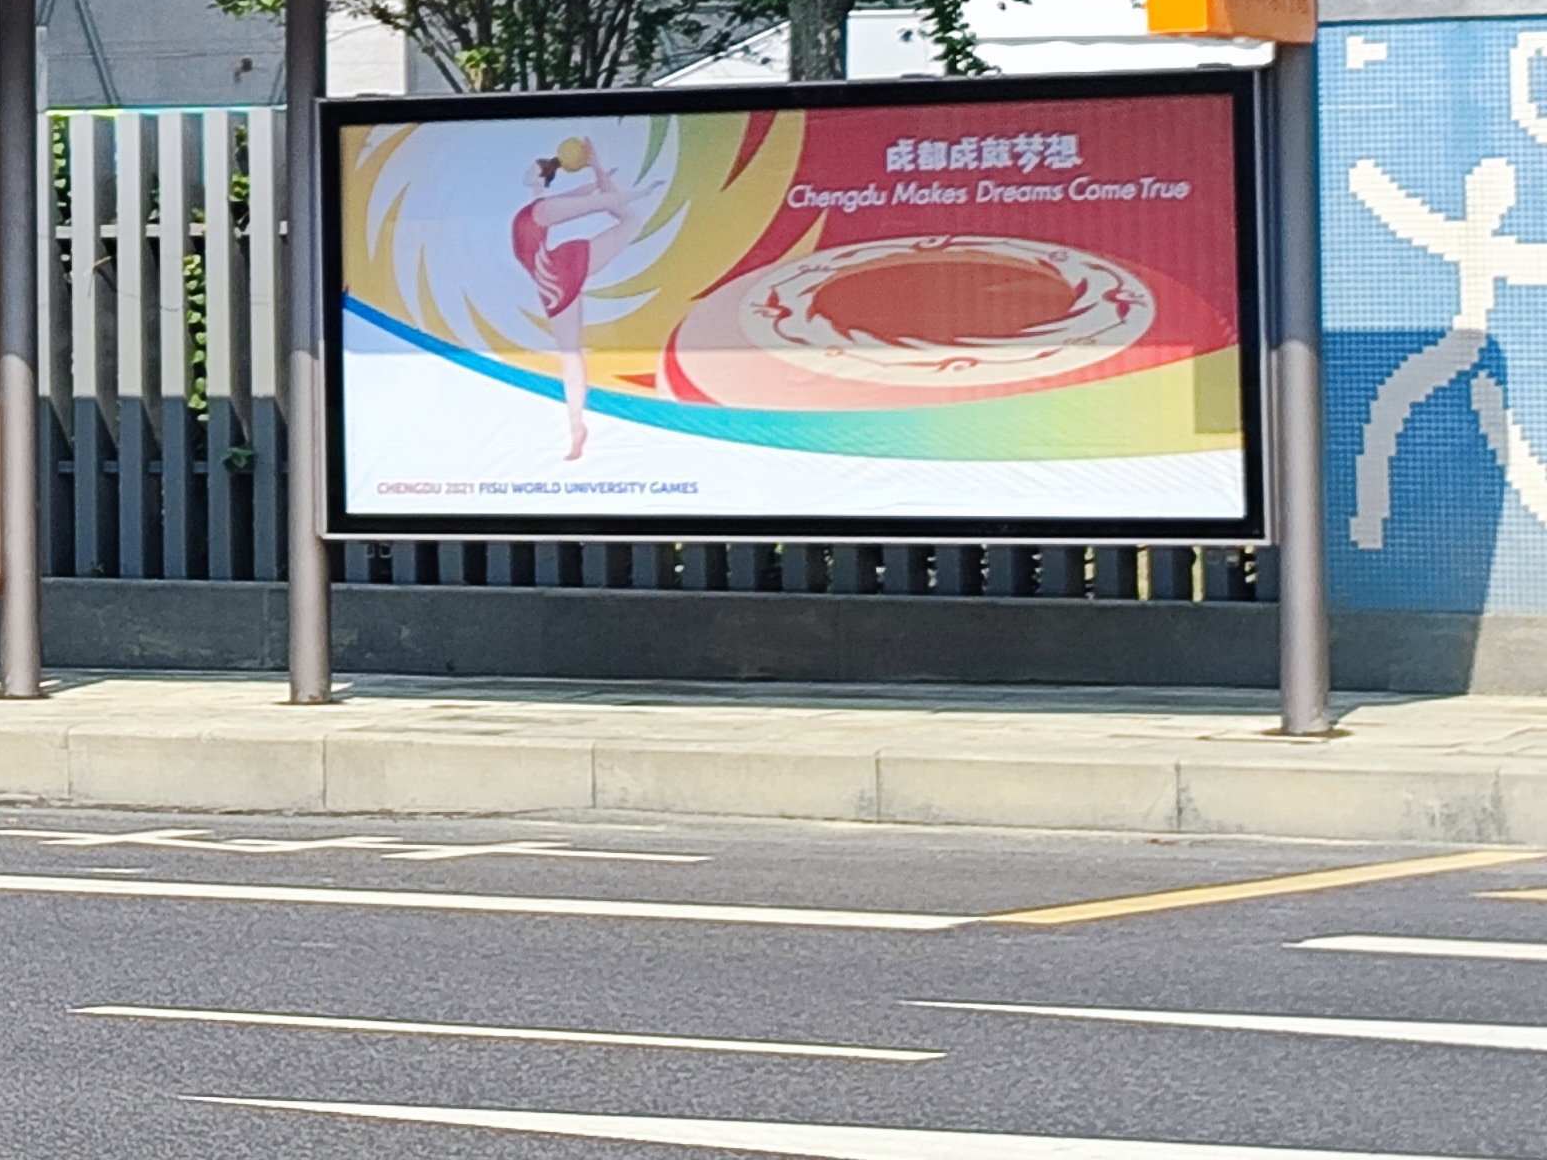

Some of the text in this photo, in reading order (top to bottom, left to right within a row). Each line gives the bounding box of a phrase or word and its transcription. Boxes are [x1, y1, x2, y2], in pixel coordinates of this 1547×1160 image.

[886, 133, 1083, 173] 成都成就梦想
[786, 177, 1191, 213] Chengdu Makes Dreams Come True
[511, 482, 561, 495] WORLD
[564, 481, 648, 495] UNIVERSITY
[650, 481, 699, 495] GAMES
